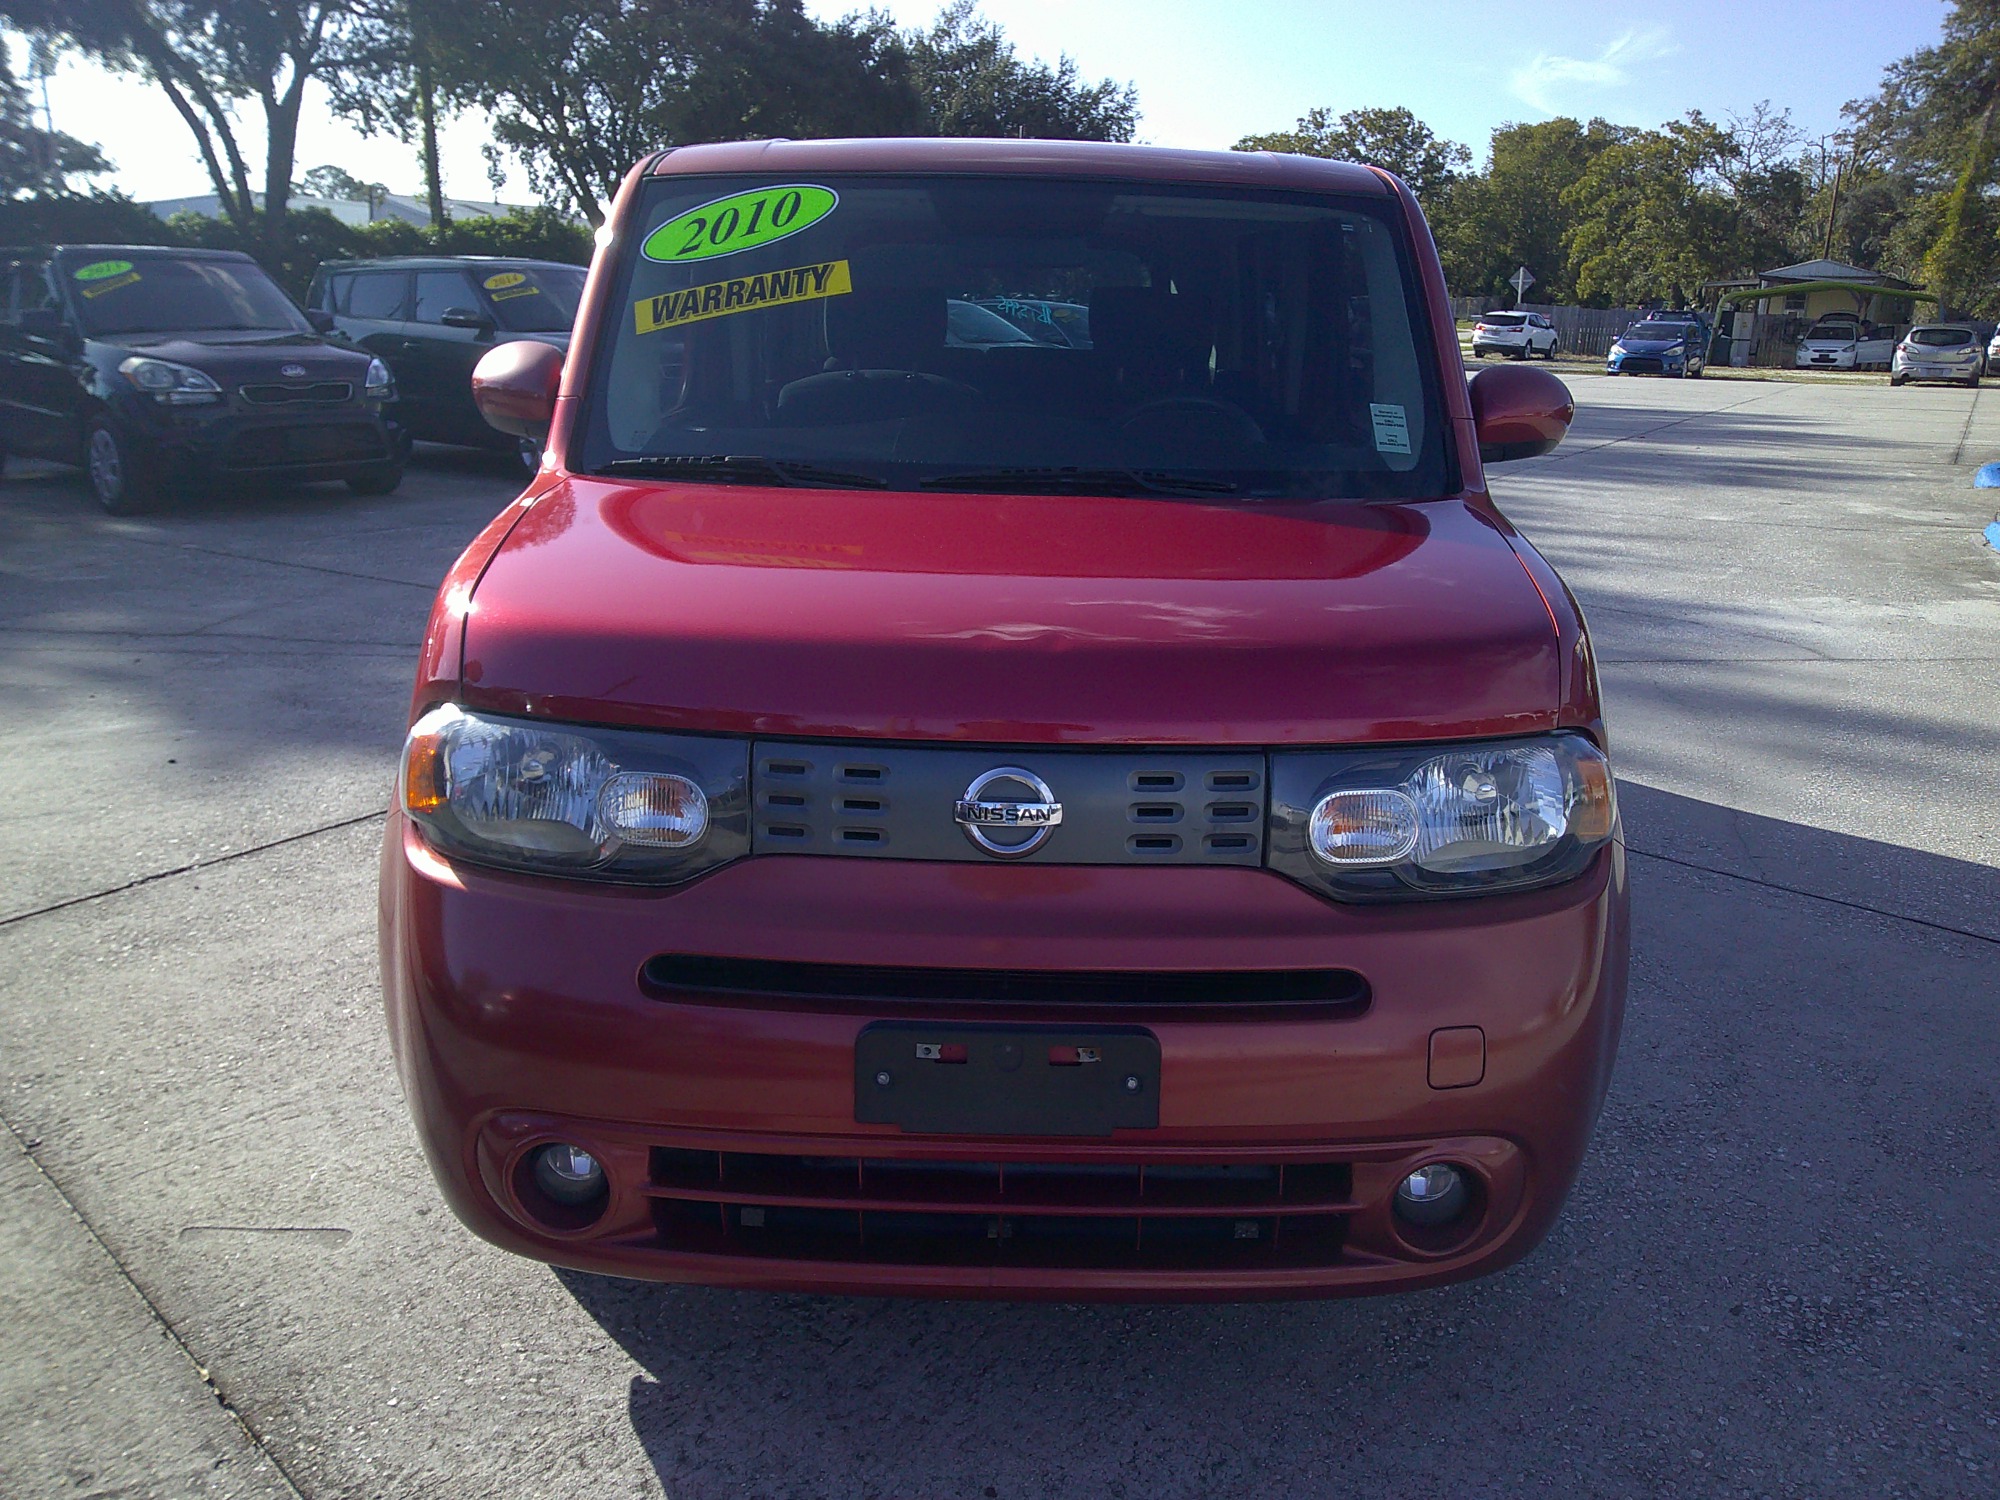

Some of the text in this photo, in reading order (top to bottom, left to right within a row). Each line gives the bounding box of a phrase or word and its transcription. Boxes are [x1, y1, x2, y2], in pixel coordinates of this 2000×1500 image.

[676, 191, 802, 256] 2010
[651, 264, 836, 326] WARRANTY
[966, 806, 1051, 822] NISSAN
